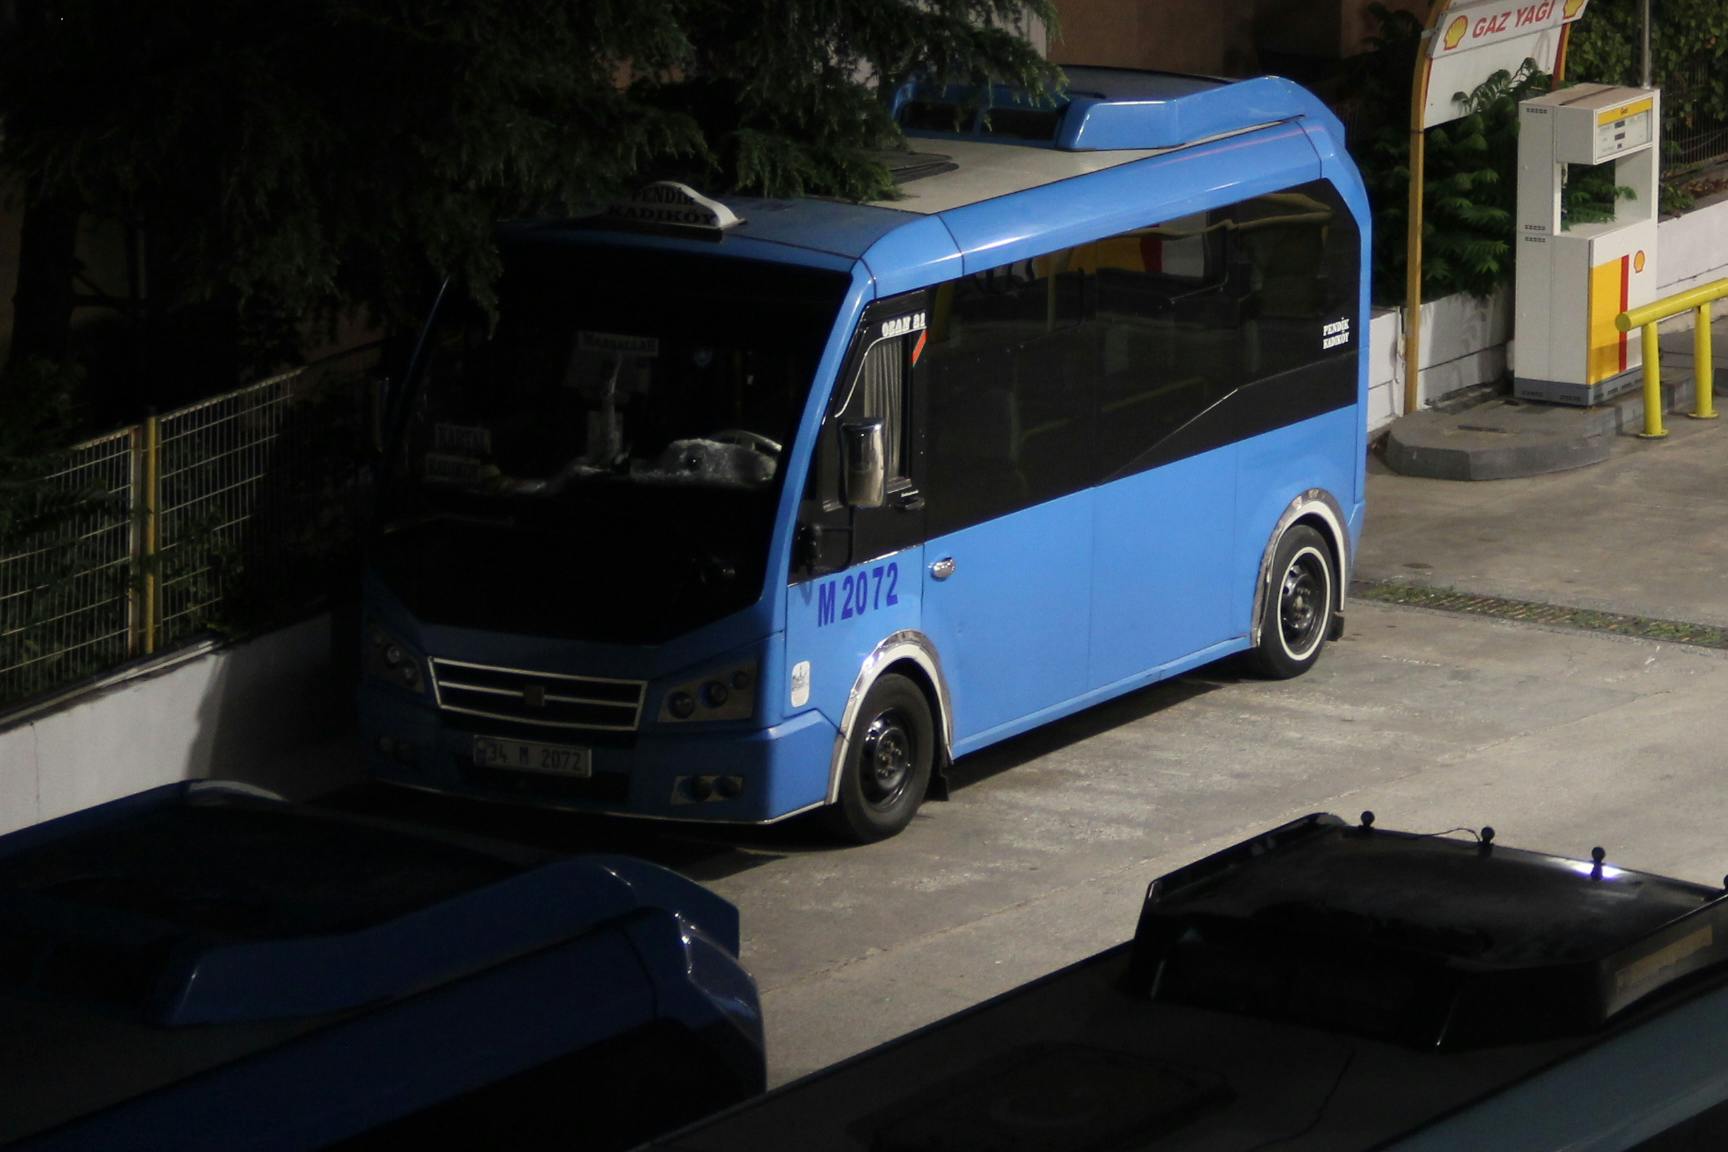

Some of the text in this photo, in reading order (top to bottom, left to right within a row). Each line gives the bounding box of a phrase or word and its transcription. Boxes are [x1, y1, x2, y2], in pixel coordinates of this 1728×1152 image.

[1472, 11, 1512, 38] GAZ
[608, 204, 714, 225] KADIKÖY
[817, 560, 899, 628] M 2072
[488, 742, 582, 772] 34 M 2072
